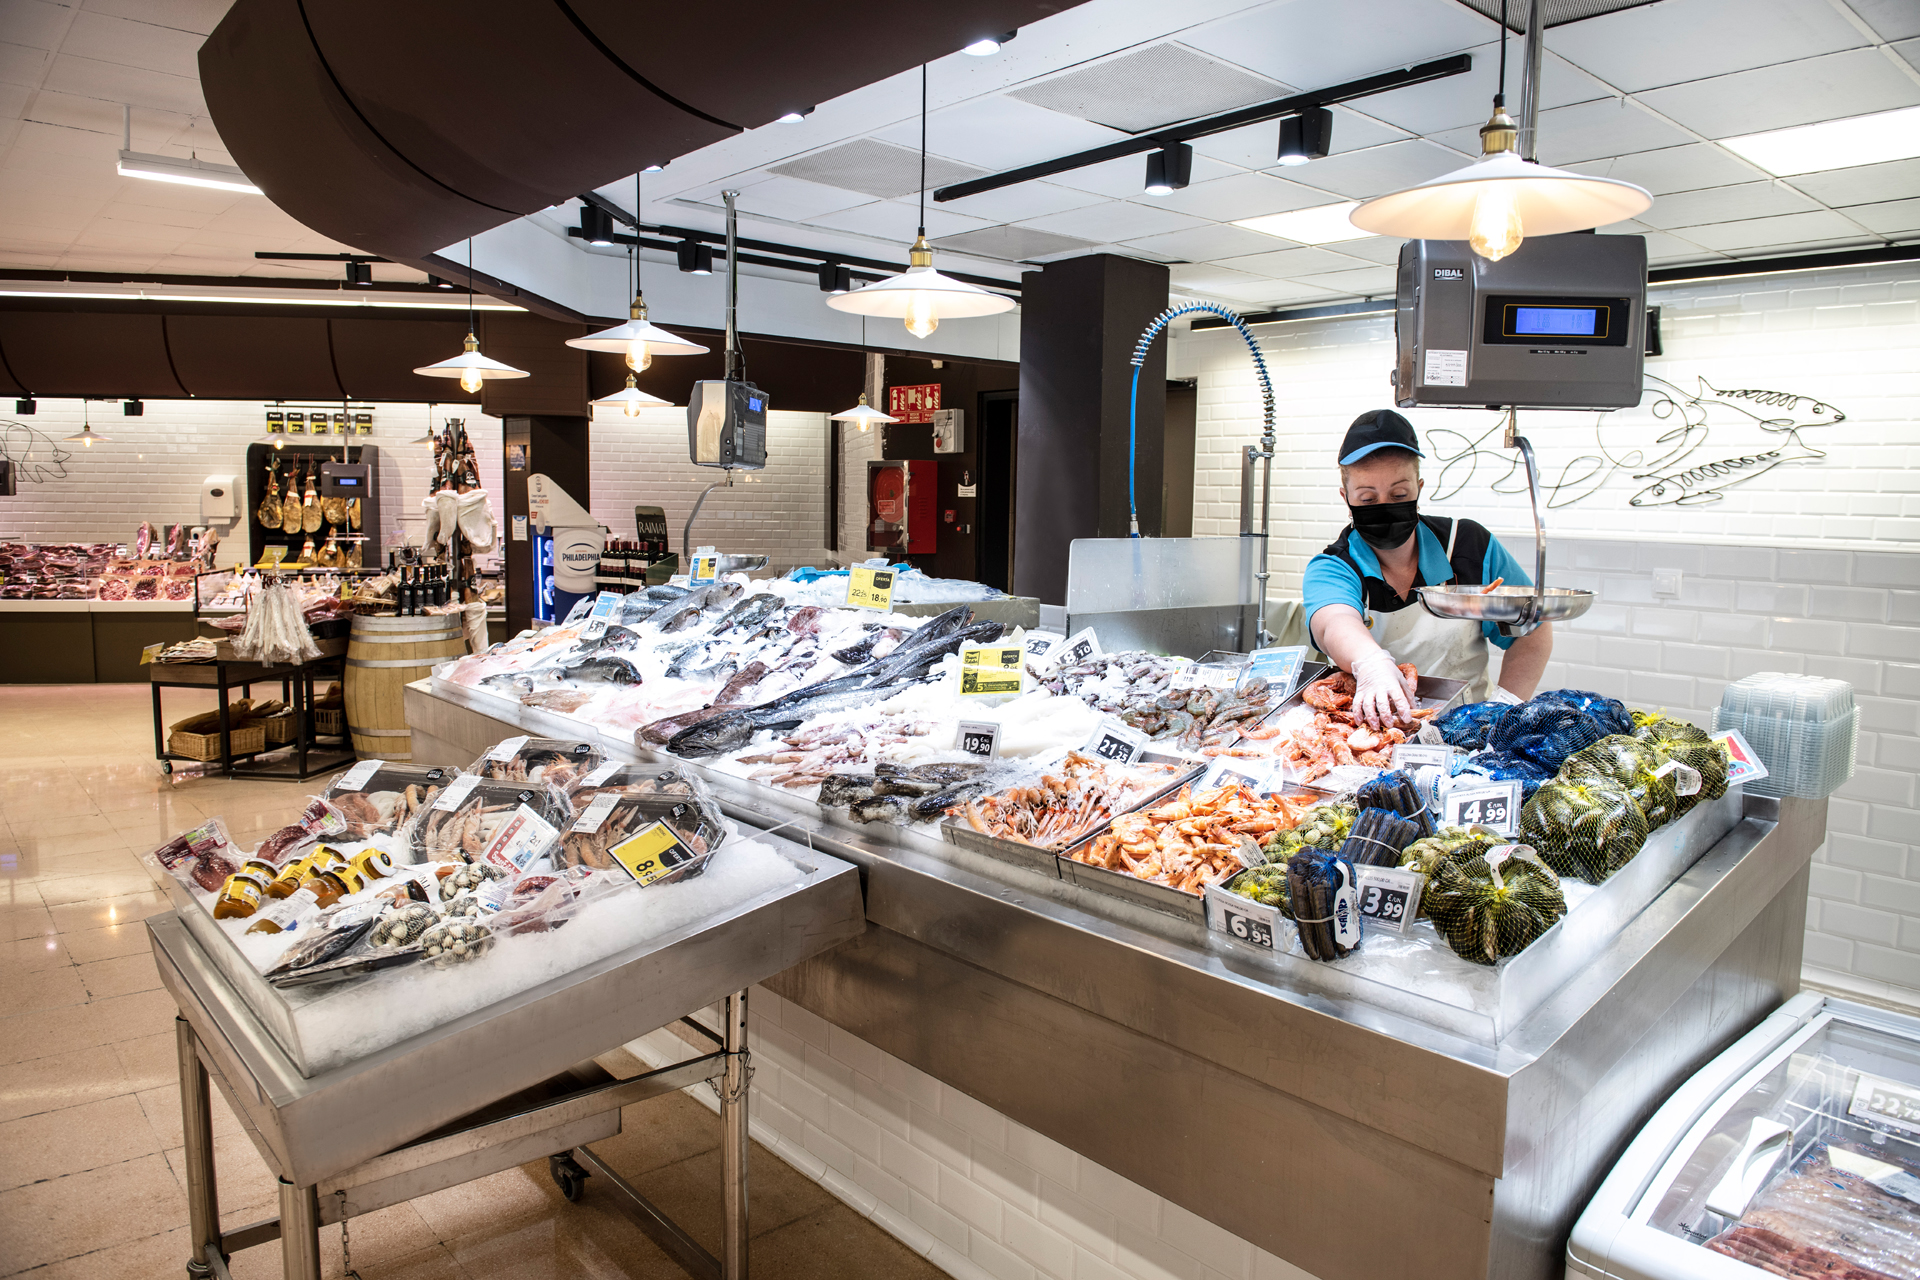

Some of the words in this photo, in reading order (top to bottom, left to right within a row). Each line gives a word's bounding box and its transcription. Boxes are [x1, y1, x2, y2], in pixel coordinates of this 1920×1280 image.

[1434, 268, 1463, 278] DIBAL
[638, 521, 666, 535] RAIMAT
[562, 552, 600, 562] PHILADELPHIA
[964, 736, 991, 756] 19,90
[1100, 738, 1129, 763] 21,25
[1463, 800, 1507, 824] 4,99
[1363, 887, 1404, 918] 3,99
[1230, 914, 1272, 947] 6,95
[1872, 1092, 1920, 1121] 22,79
